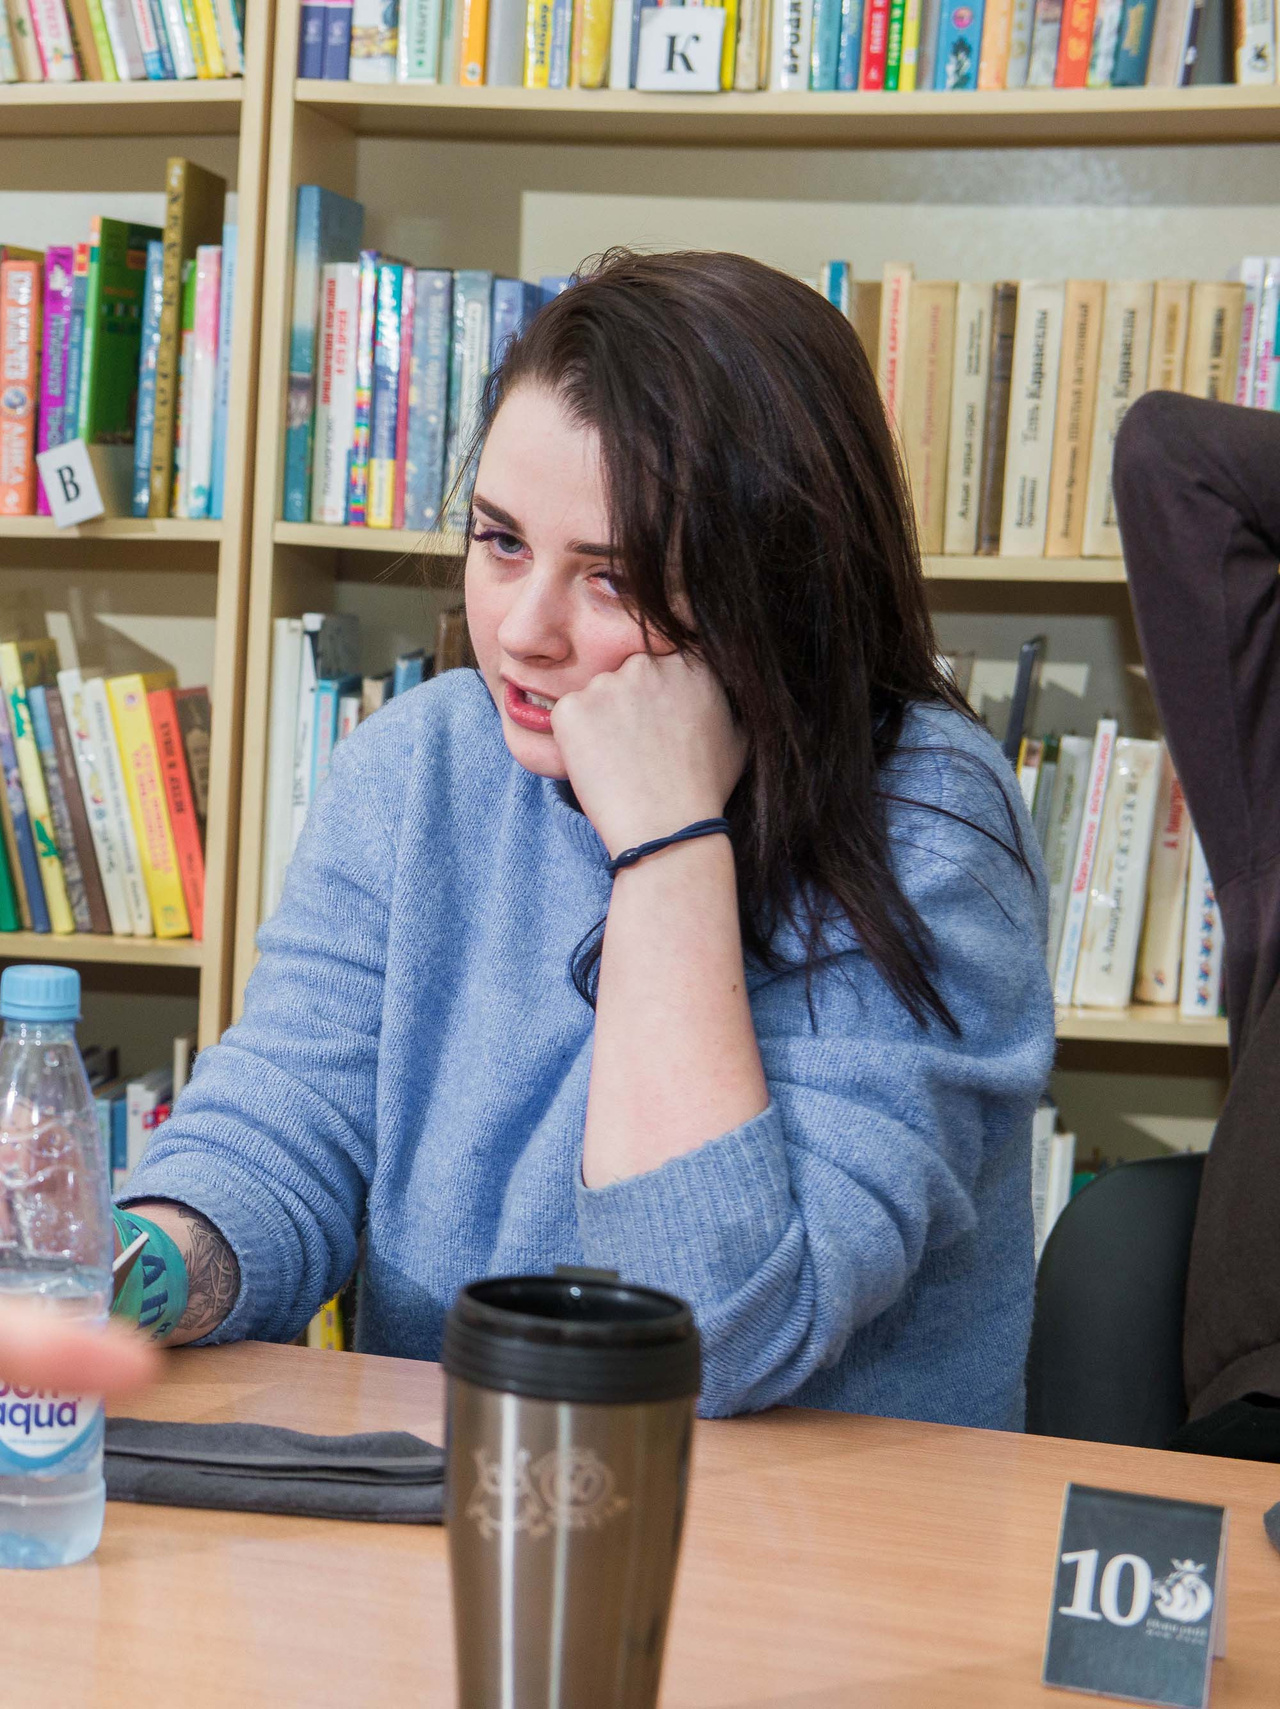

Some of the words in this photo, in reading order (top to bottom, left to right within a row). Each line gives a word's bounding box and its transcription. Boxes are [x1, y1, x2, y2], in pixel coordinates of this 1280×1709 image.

[664, 34, 701, 74] К
[57, 466, 80, 502] В
[1058, 1548, 1153, 1627] 10
